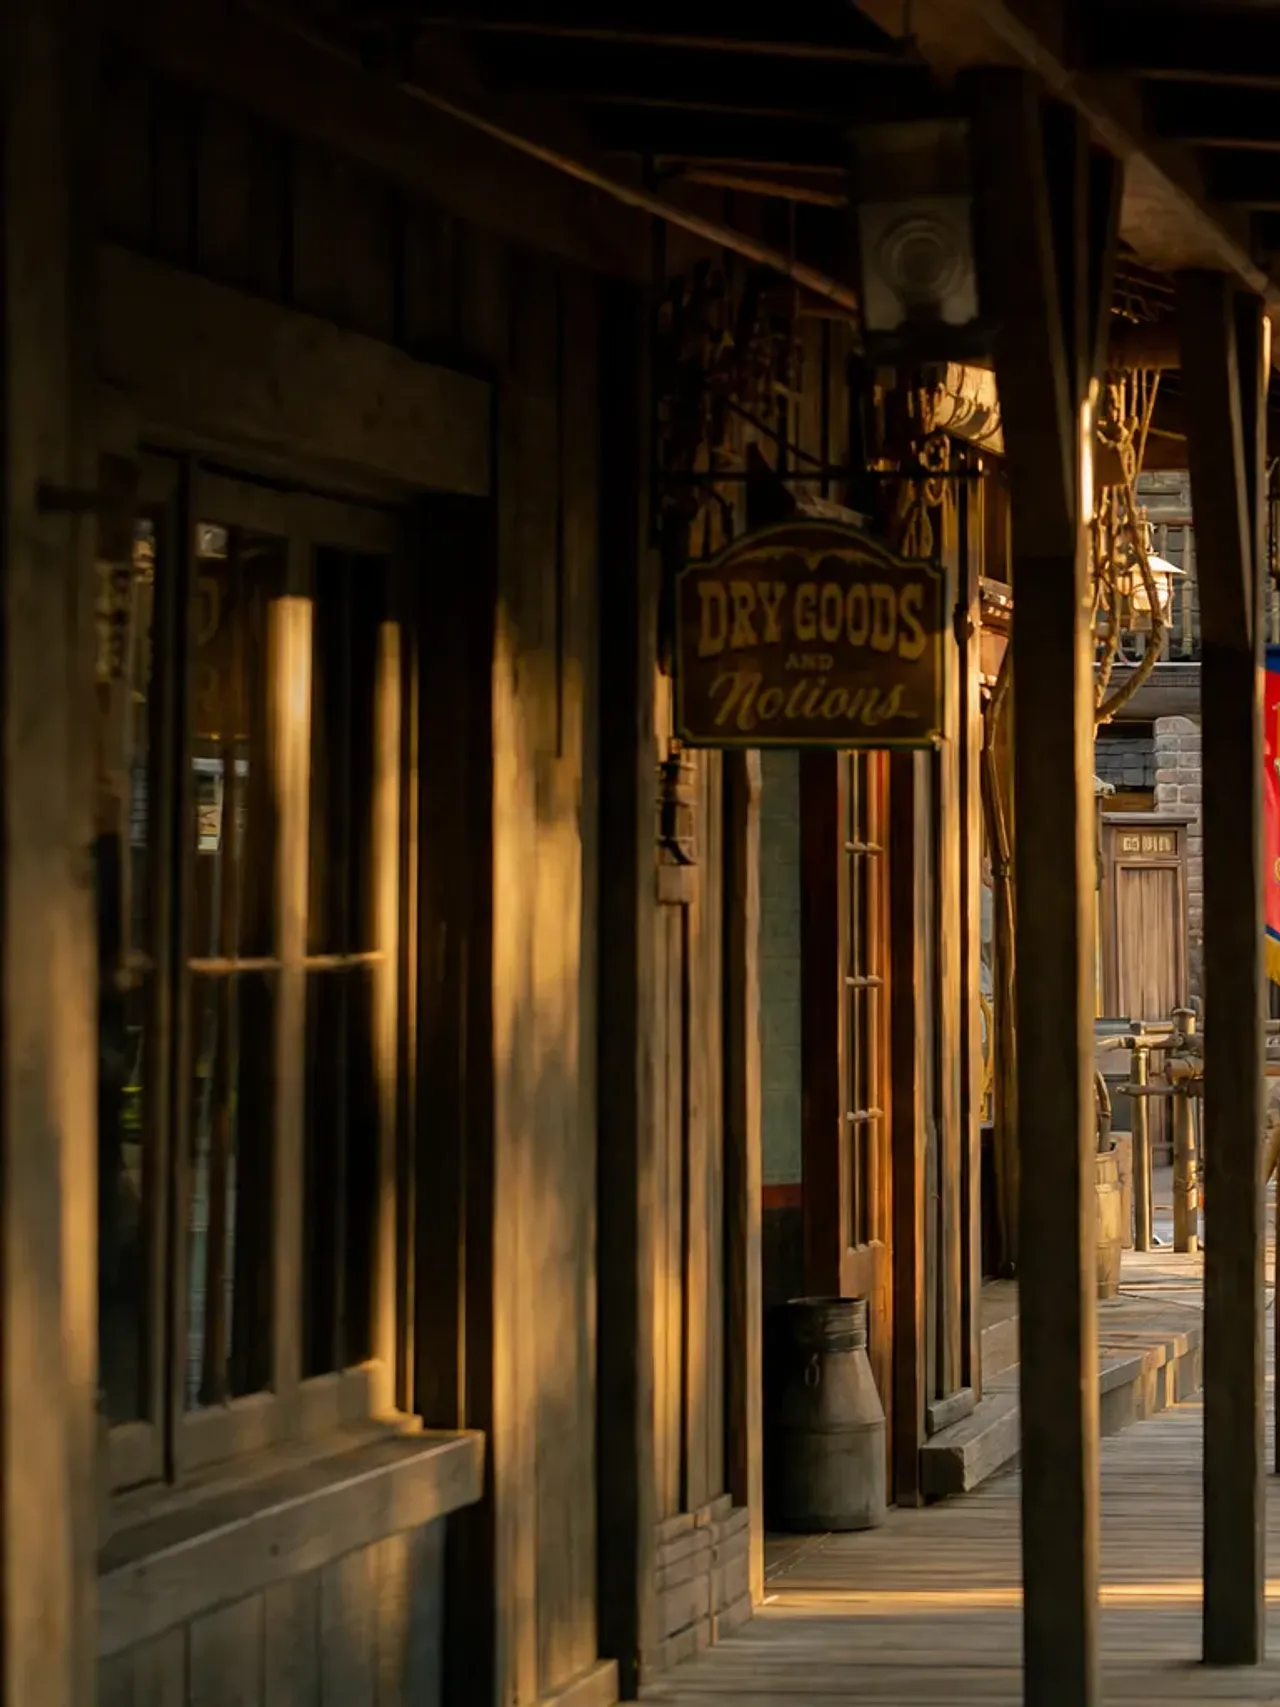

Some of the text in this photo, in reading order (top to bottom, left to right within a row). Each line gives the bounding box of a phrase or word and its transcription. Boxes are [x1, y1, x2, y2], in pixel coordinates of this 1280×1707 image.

[698, 580, 927, 661] DRY GOODS
[785, 652, 834, 671] AND
[708, 671, 920, 731] Notions
